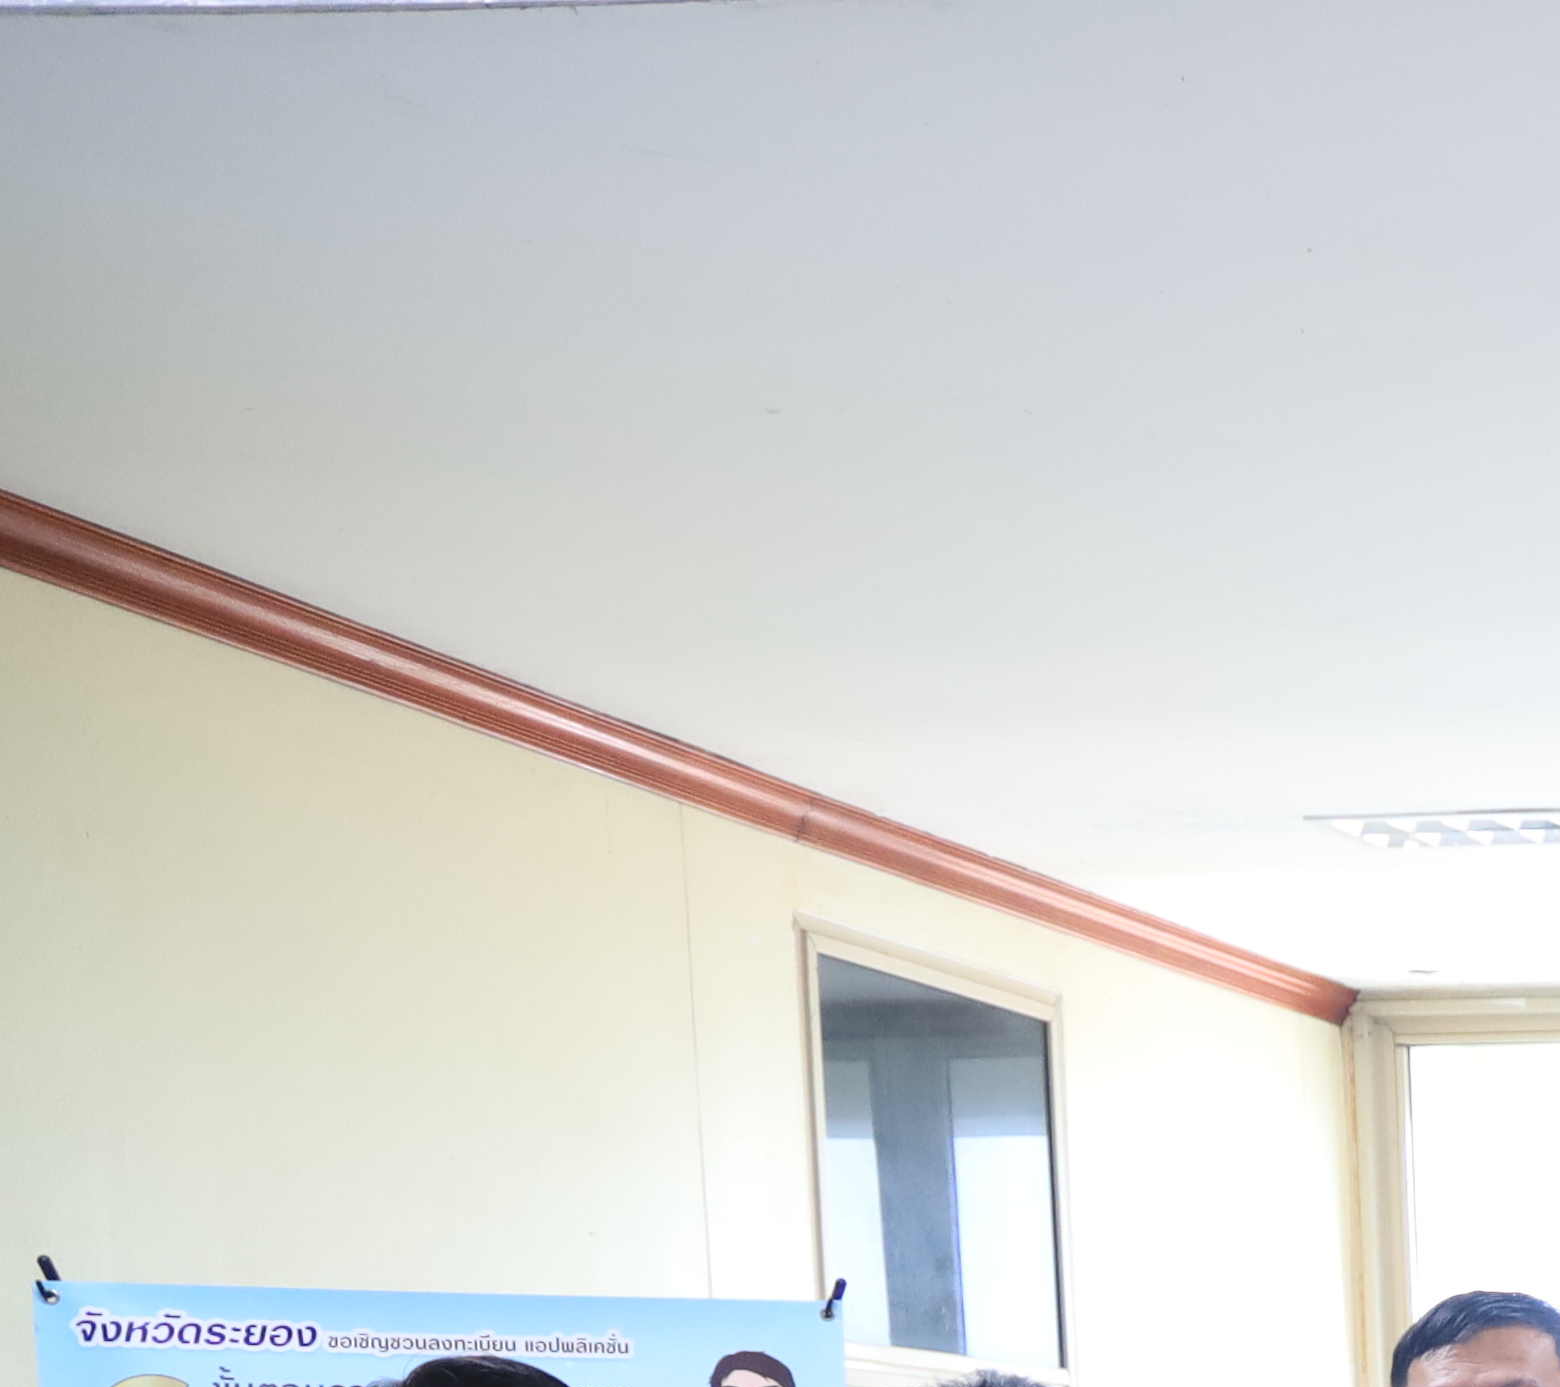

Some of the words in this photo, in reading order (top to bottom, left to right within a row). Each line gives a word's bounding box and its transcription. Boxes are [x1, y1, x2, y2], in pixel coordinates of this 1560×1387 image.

[76, 1311, 318, 1349] จังหวัดระยอง
[327, 1333, 517, 1353] ขอเชิญชวนลงทะเบียน
